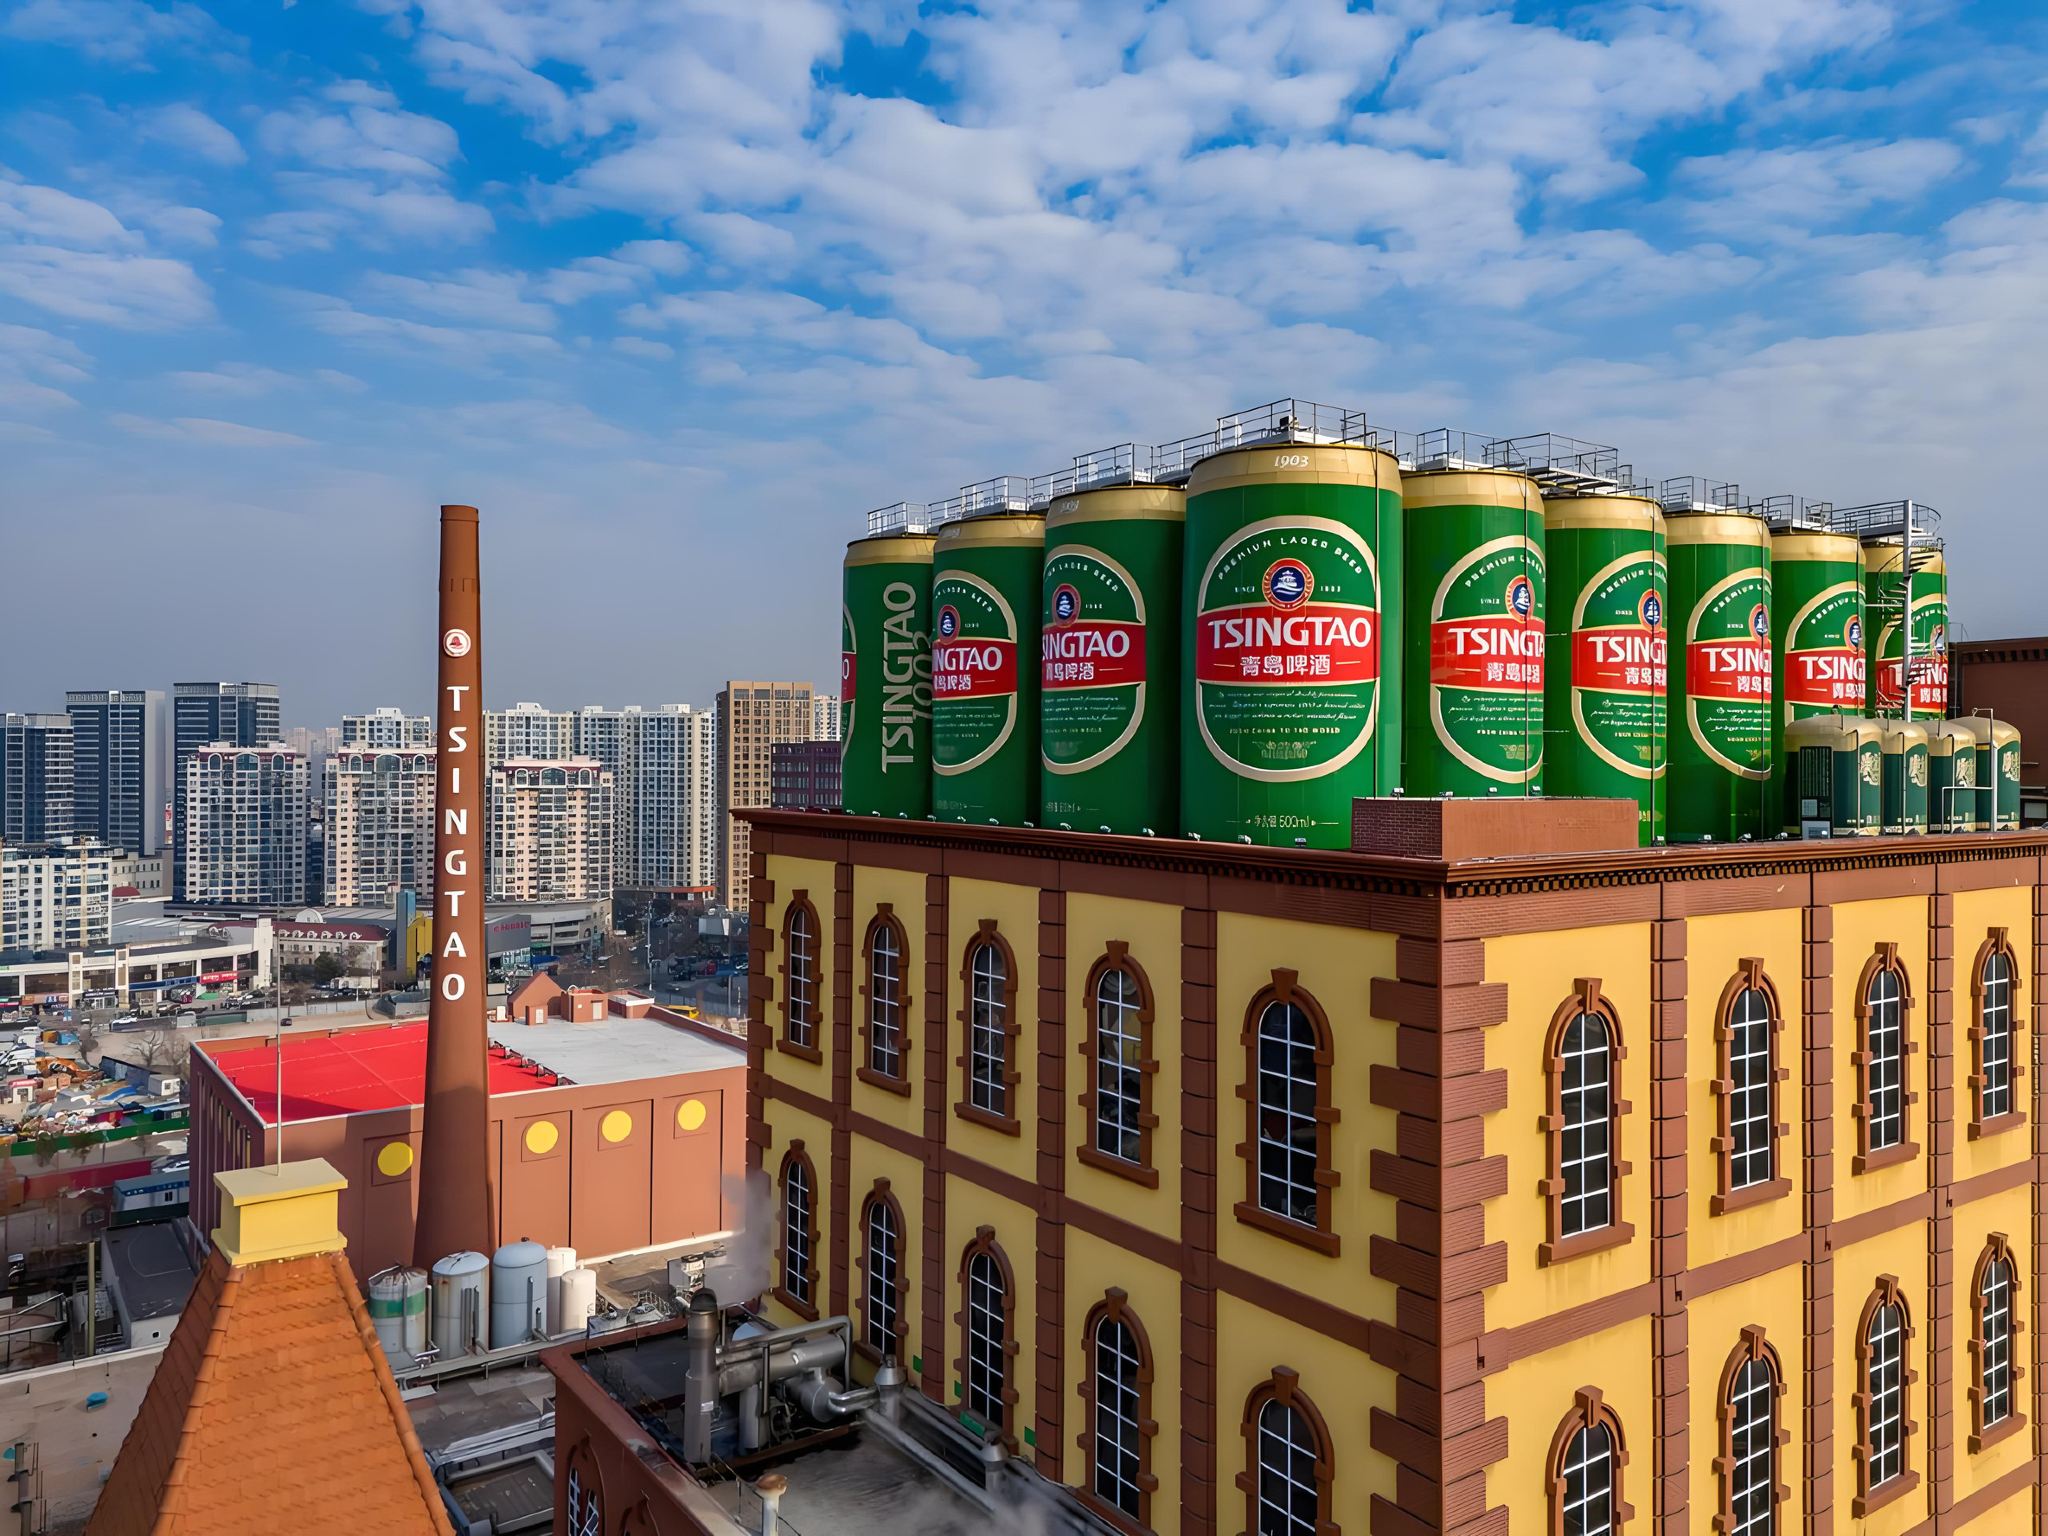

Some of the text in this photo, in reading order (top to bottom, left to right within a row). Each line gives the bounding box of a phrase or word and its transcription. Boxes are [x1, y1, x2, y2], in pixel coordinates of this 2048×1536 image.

[1273, 455, 1309, 468] 1903
[1207, 616, 1372, 649] TSINGTAO
[881, 581, 917, 774] TSINGTAO
[1240, 654, 1330, 676] 青岛啤酒
[441, 685, 470, 1001] TSINGTAO
